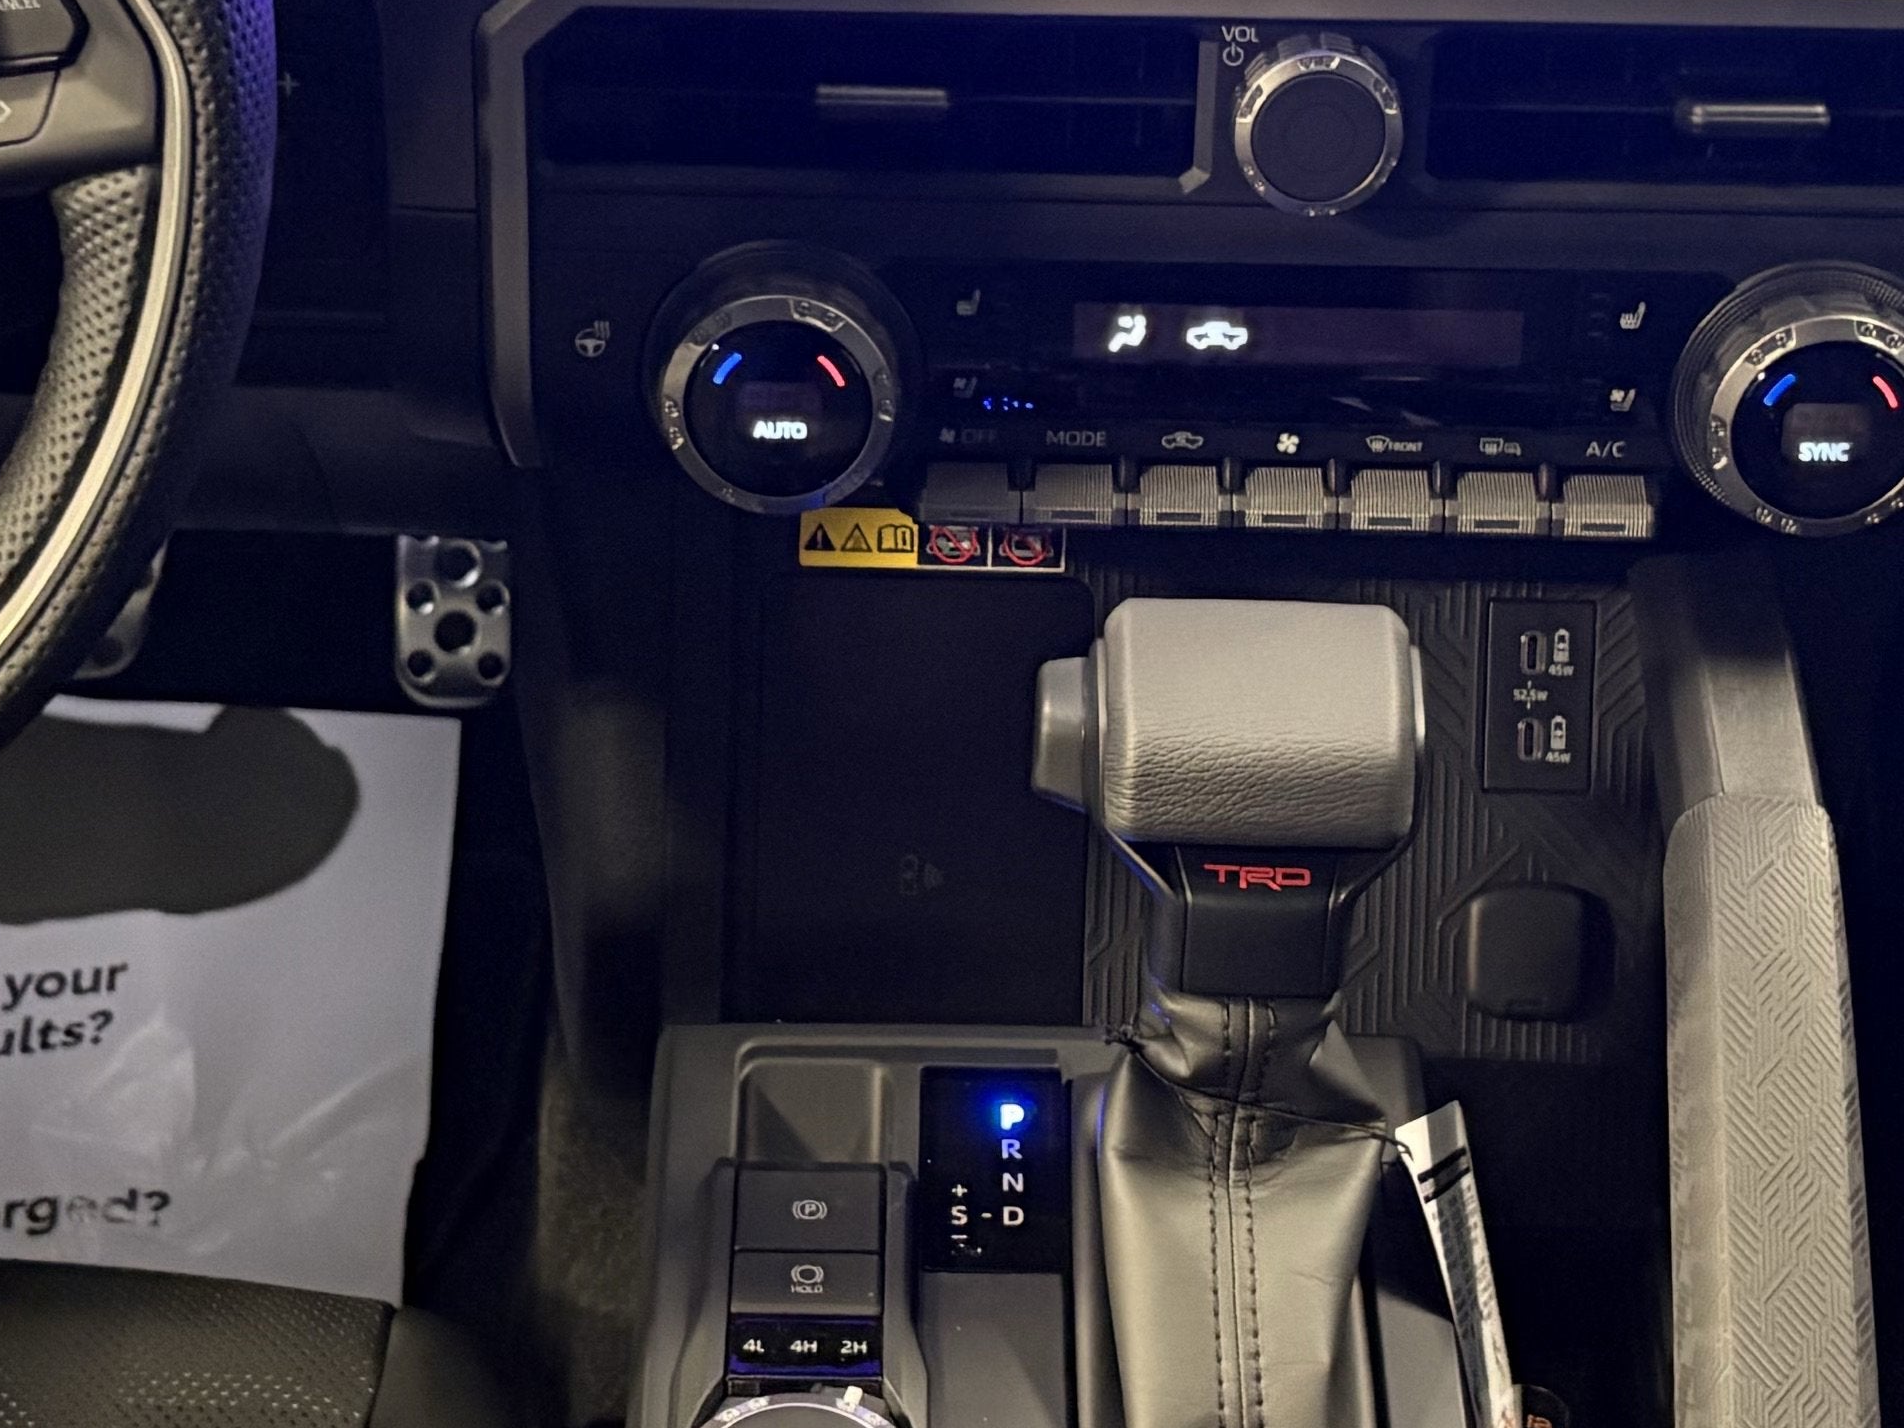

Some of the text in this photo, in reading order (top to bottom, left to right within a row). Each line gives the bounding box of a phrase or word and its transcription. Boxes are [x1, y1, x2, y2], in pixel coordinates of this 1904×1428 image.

[1222, 26, 1259, 43] VOL
[753, 420, 808, 440] AUTO
[1046, 430, 1107, 446] MODE
[1388, 441, 1423, 453] FRONT
[1586, 440, 1626, 459] A/C
[1798, 442, 1851, 462] SYNC
[1203, 864, 1311, 891] TRD
[1, 962, 129, 1011] your
[1000, 1104, 1025, 1130] P
[1001, 1140, 1023, 1159] R
[1002, 1173, 1024, 1193] N
[952, 1206, 1025, 1226] S D
[791, 1284, 823, 1294] HOLD
[742, 1339, 867, 1354] 4L 4H 2H
